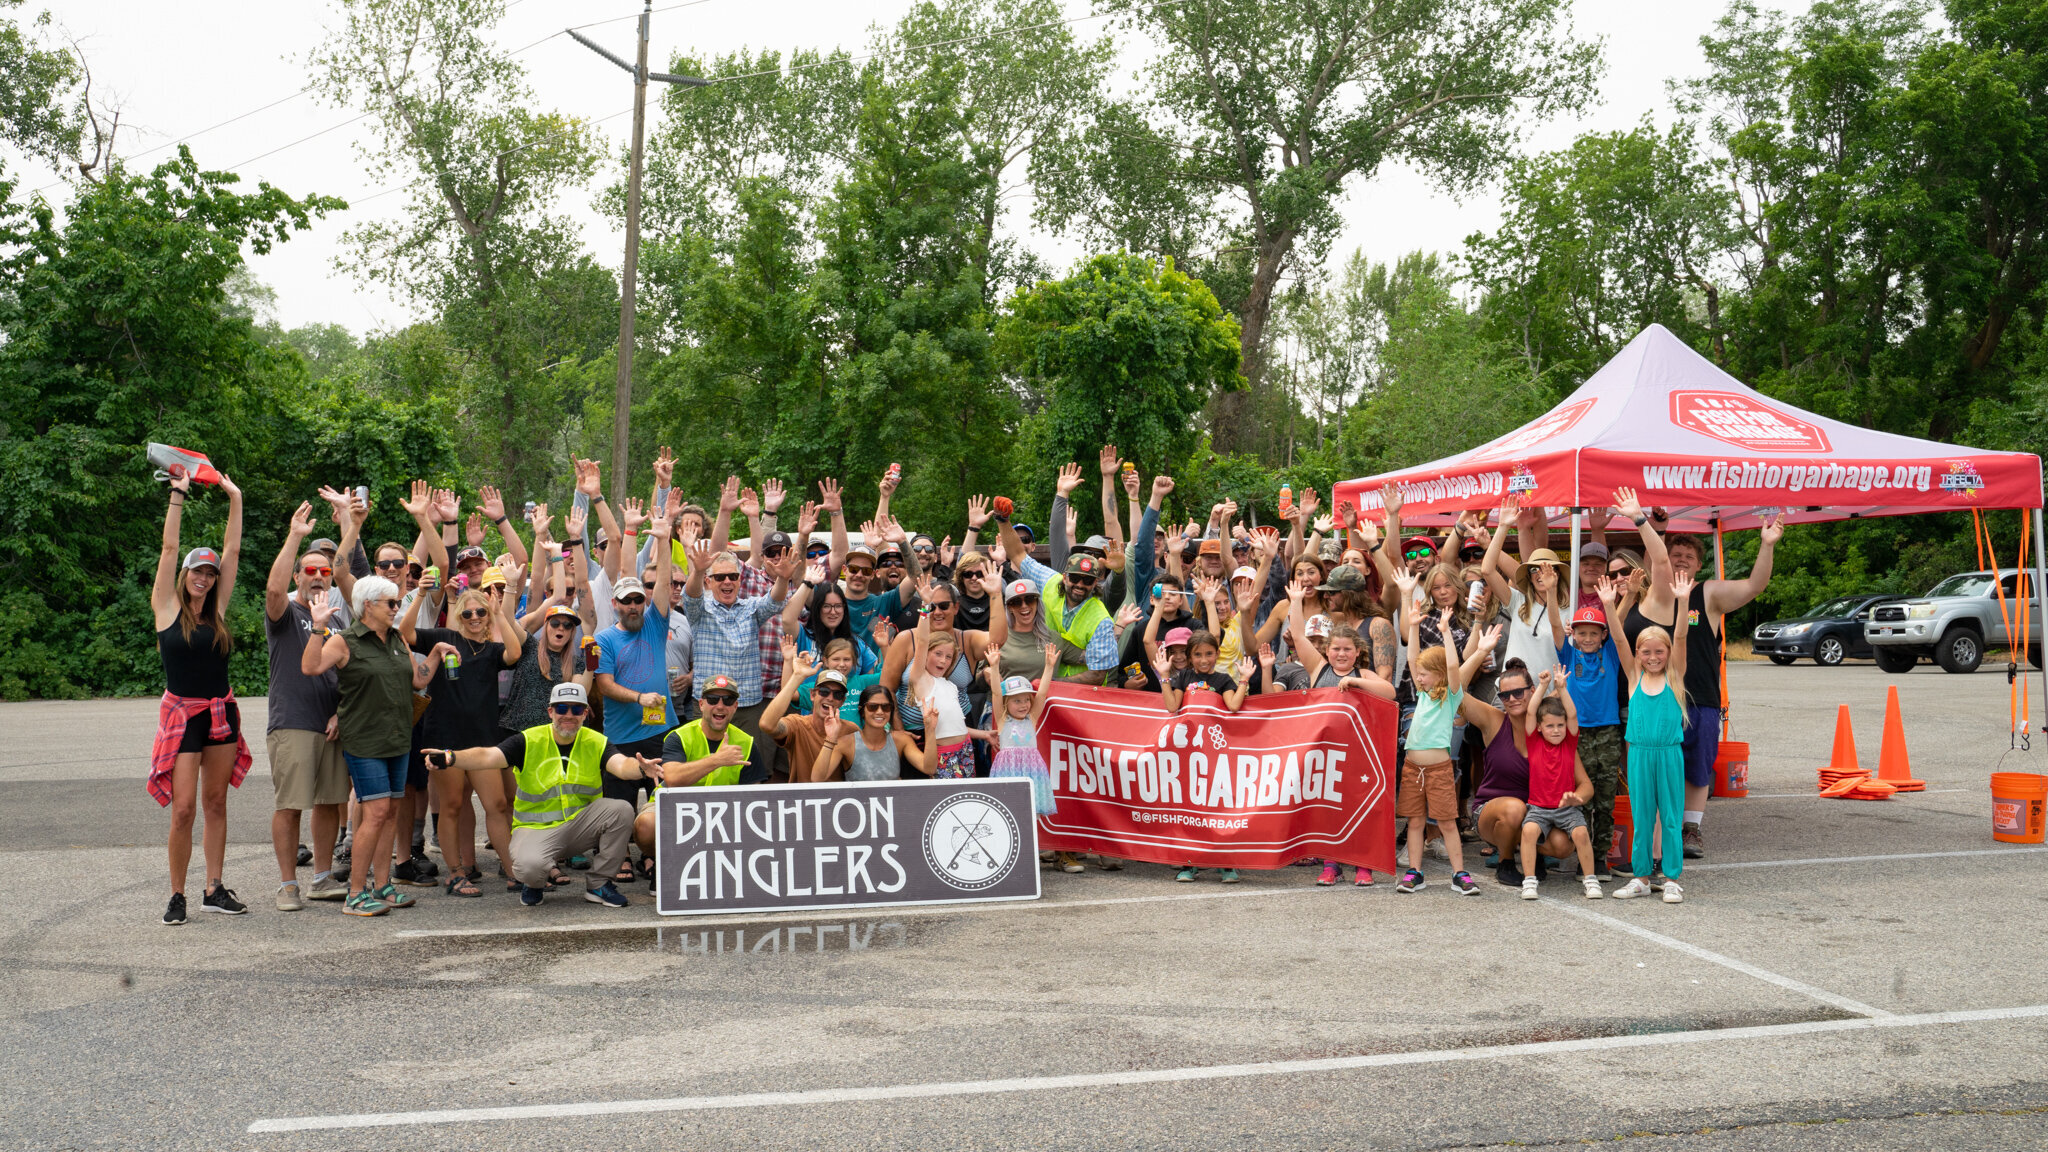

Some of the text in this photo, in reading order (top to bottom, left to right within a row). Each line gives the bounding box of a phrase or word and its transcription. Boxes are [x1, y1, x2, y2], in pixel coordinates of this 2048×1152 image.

[1688, 409, 1788, 426] FISH FOR
[1705, 424, 1812, 440] GARBAGE
[1642, 461, 1931, 492] www.fishforgarbage.org
[1940, 473, 1984, 485] TRIFECTA
[1050, 739, 1347, 809] FISH FOR GARBAGE
[675, 796, 895, 845] BRIGHTON
[1141, 811, 1249, 829] @FISHFORGARBAGE
[678, 843, 907, 901] ANGLERS
